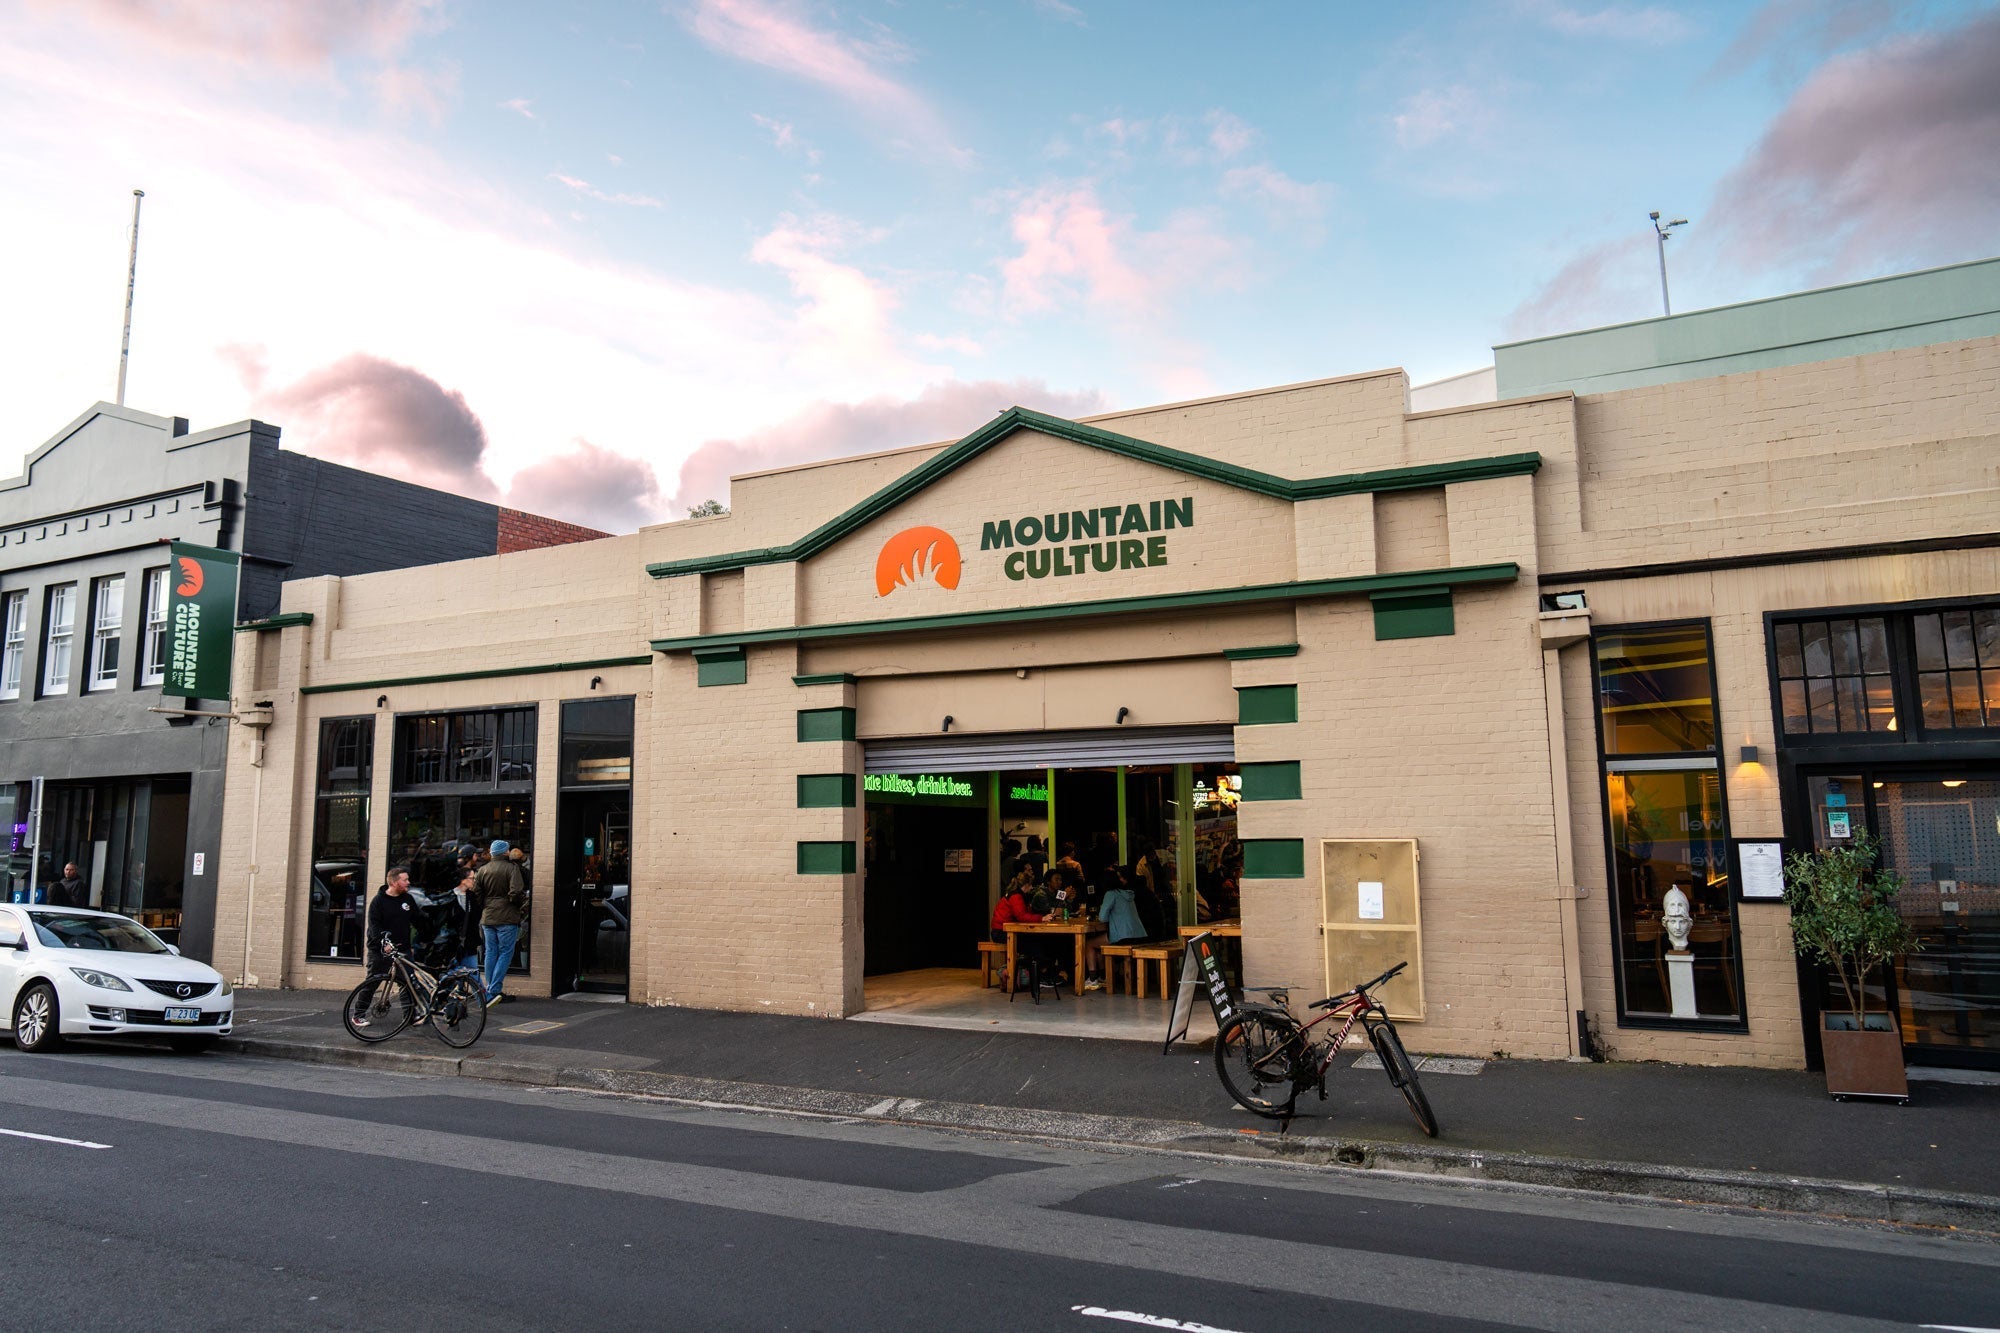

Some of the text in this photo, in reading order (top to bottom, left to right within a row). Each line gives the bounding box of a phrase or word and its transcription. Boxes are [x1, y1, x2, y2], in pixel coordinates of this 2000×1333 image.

[980, 497, 1193, 551] MOUNTAIN
[1004, 536, 1168, 581] CULTURE
[172, 603, 187, 670] CULTURE
[184, 602, 200, 689] MOUNTAIN
[882, 774, 916, 796] bikes,
[917, 775, 947, 795] drink
[947, 777, 973, 796] beer.
